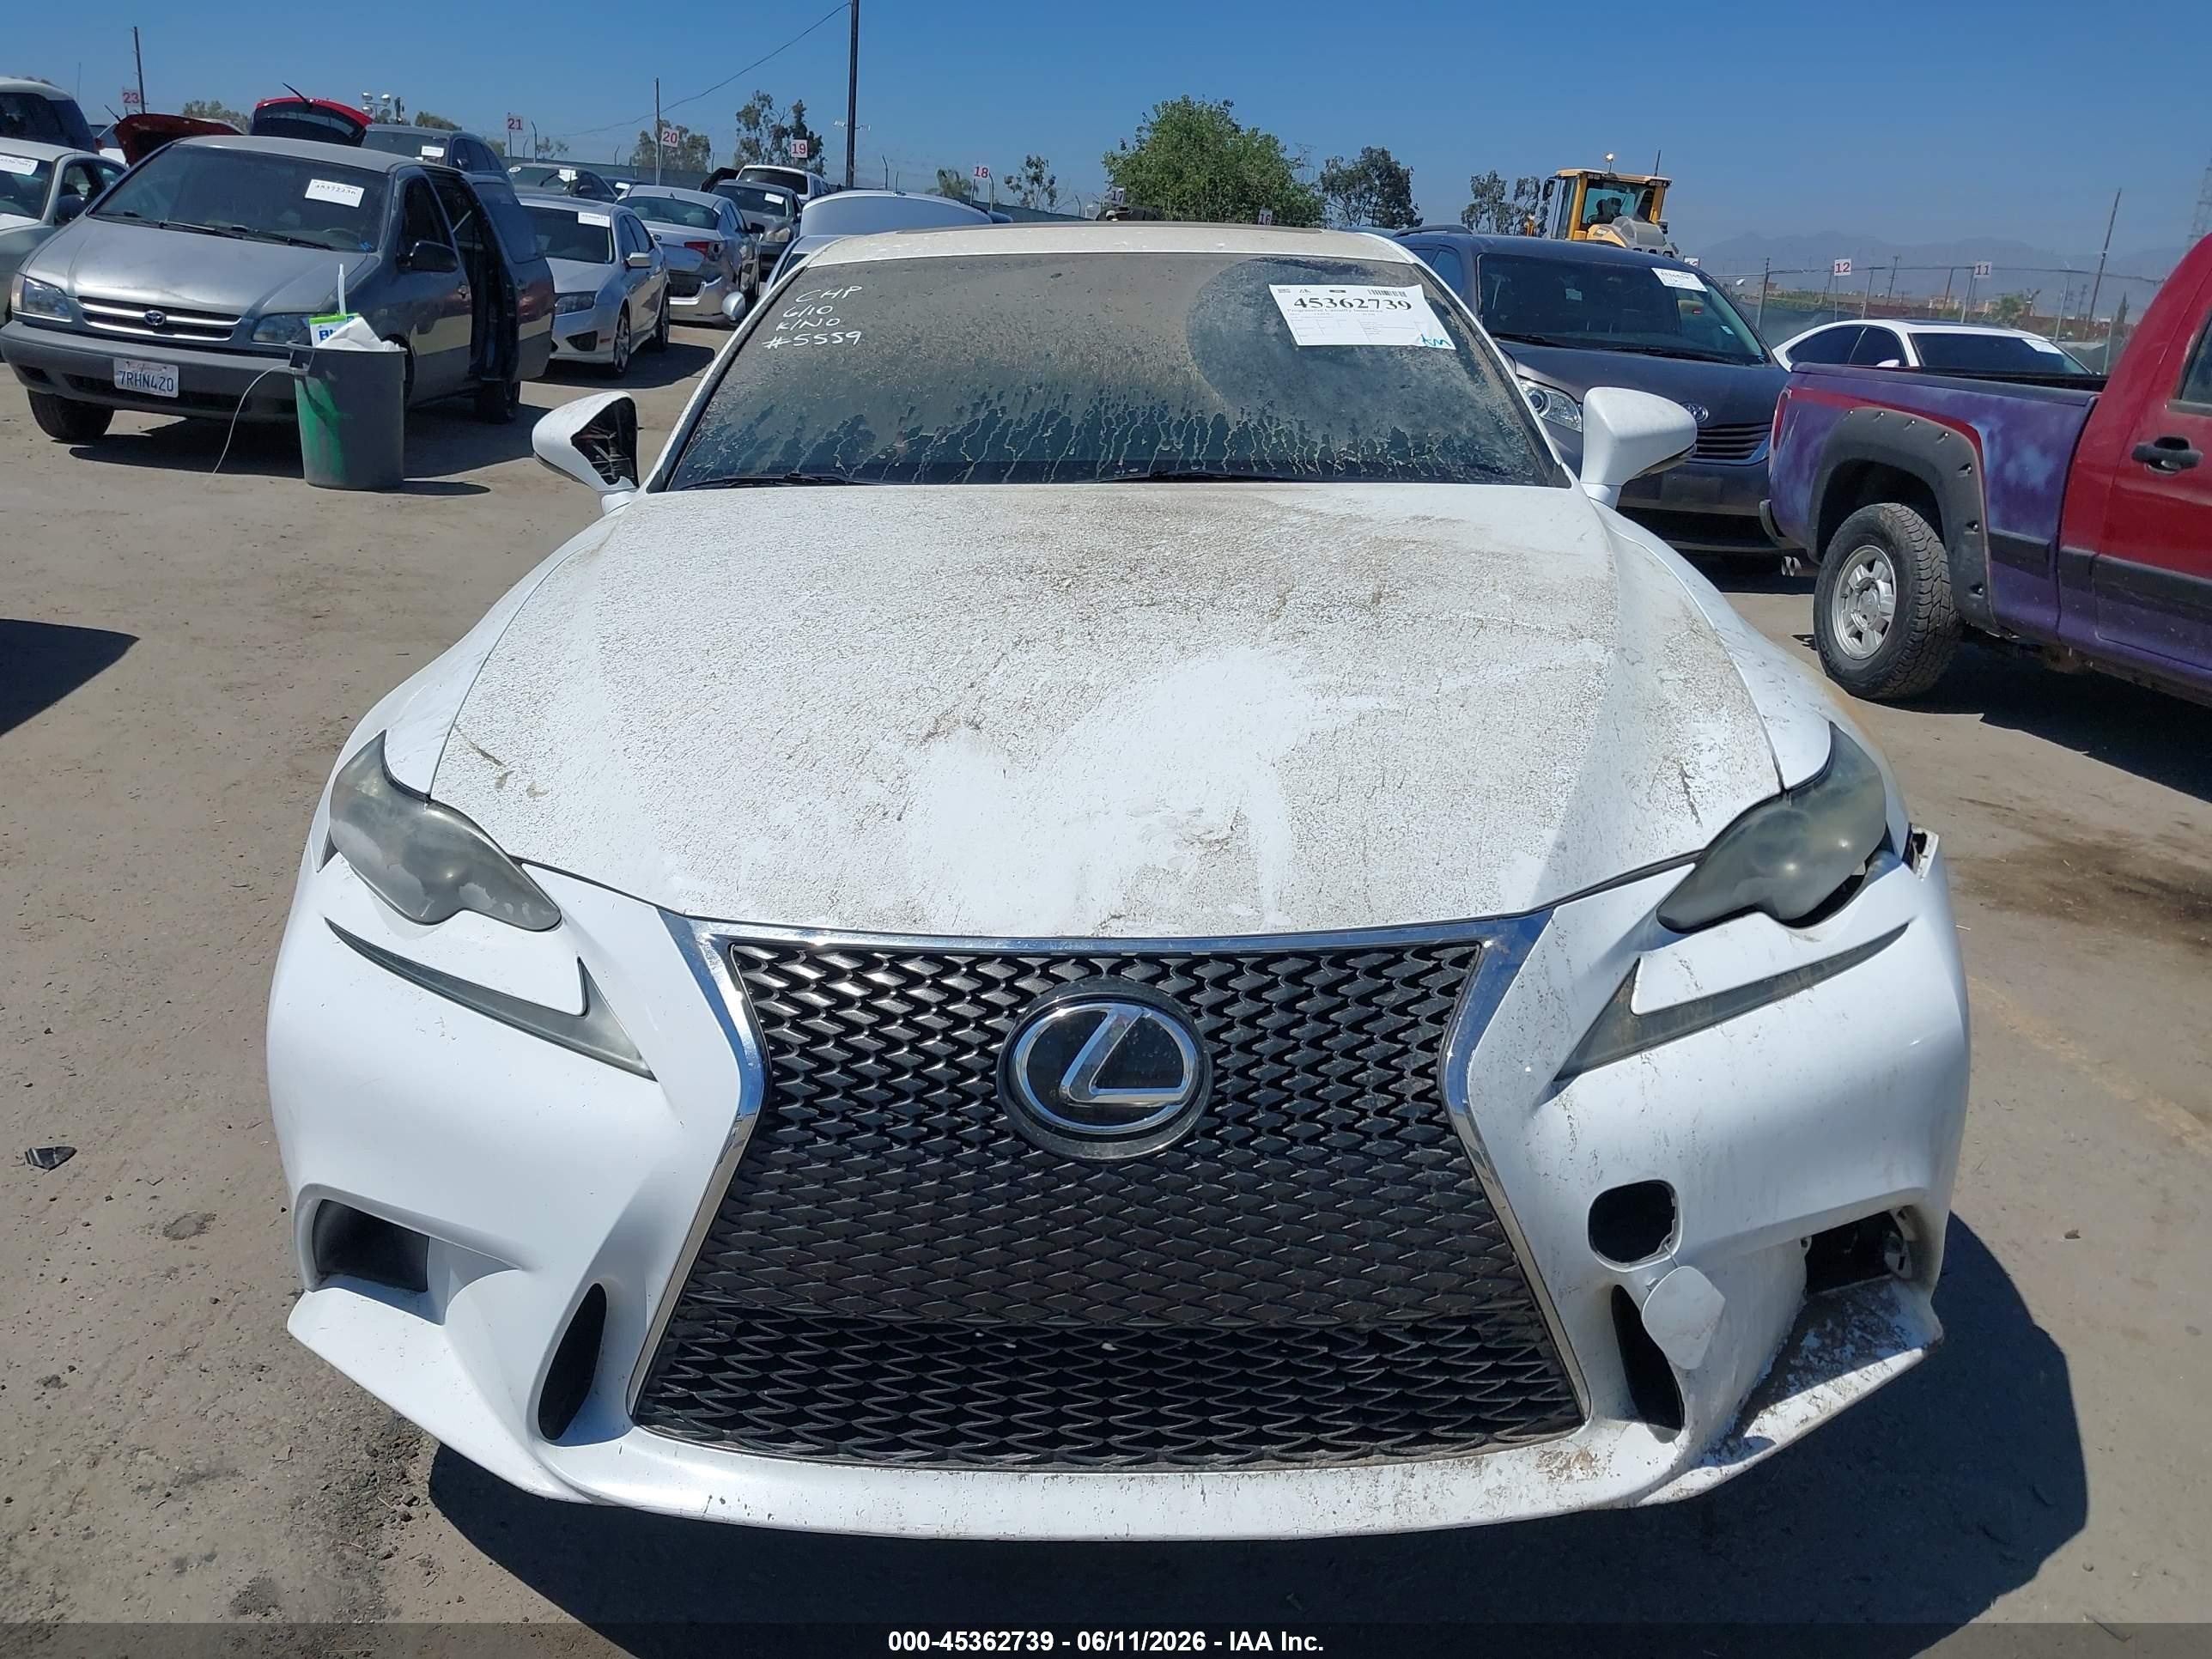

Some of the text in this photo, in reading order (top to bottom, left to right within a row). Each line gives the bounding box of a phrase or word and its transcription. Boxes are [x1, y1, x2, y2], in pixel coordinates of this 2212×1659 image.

[123, 92, 139, 104] 23
[507, 118, 522, 131] 21
[662, 131, 678, 144] 20
[792, 143, 805, 155] 19
[974, 166, 988, 179] 18
[1111, 190, 1123, 202] 17
[1835, 262, 1850, 274] 12
[1975, 264, 1990, 276] 11
[795, 285, 862, 303] CHP
[1293, 297, 1413, 311] 45362739
[782, 304, 833, 318] 6/10
[762, 331, 862, 349] #5559
[118, 370, 174, 392] 7RHN420
